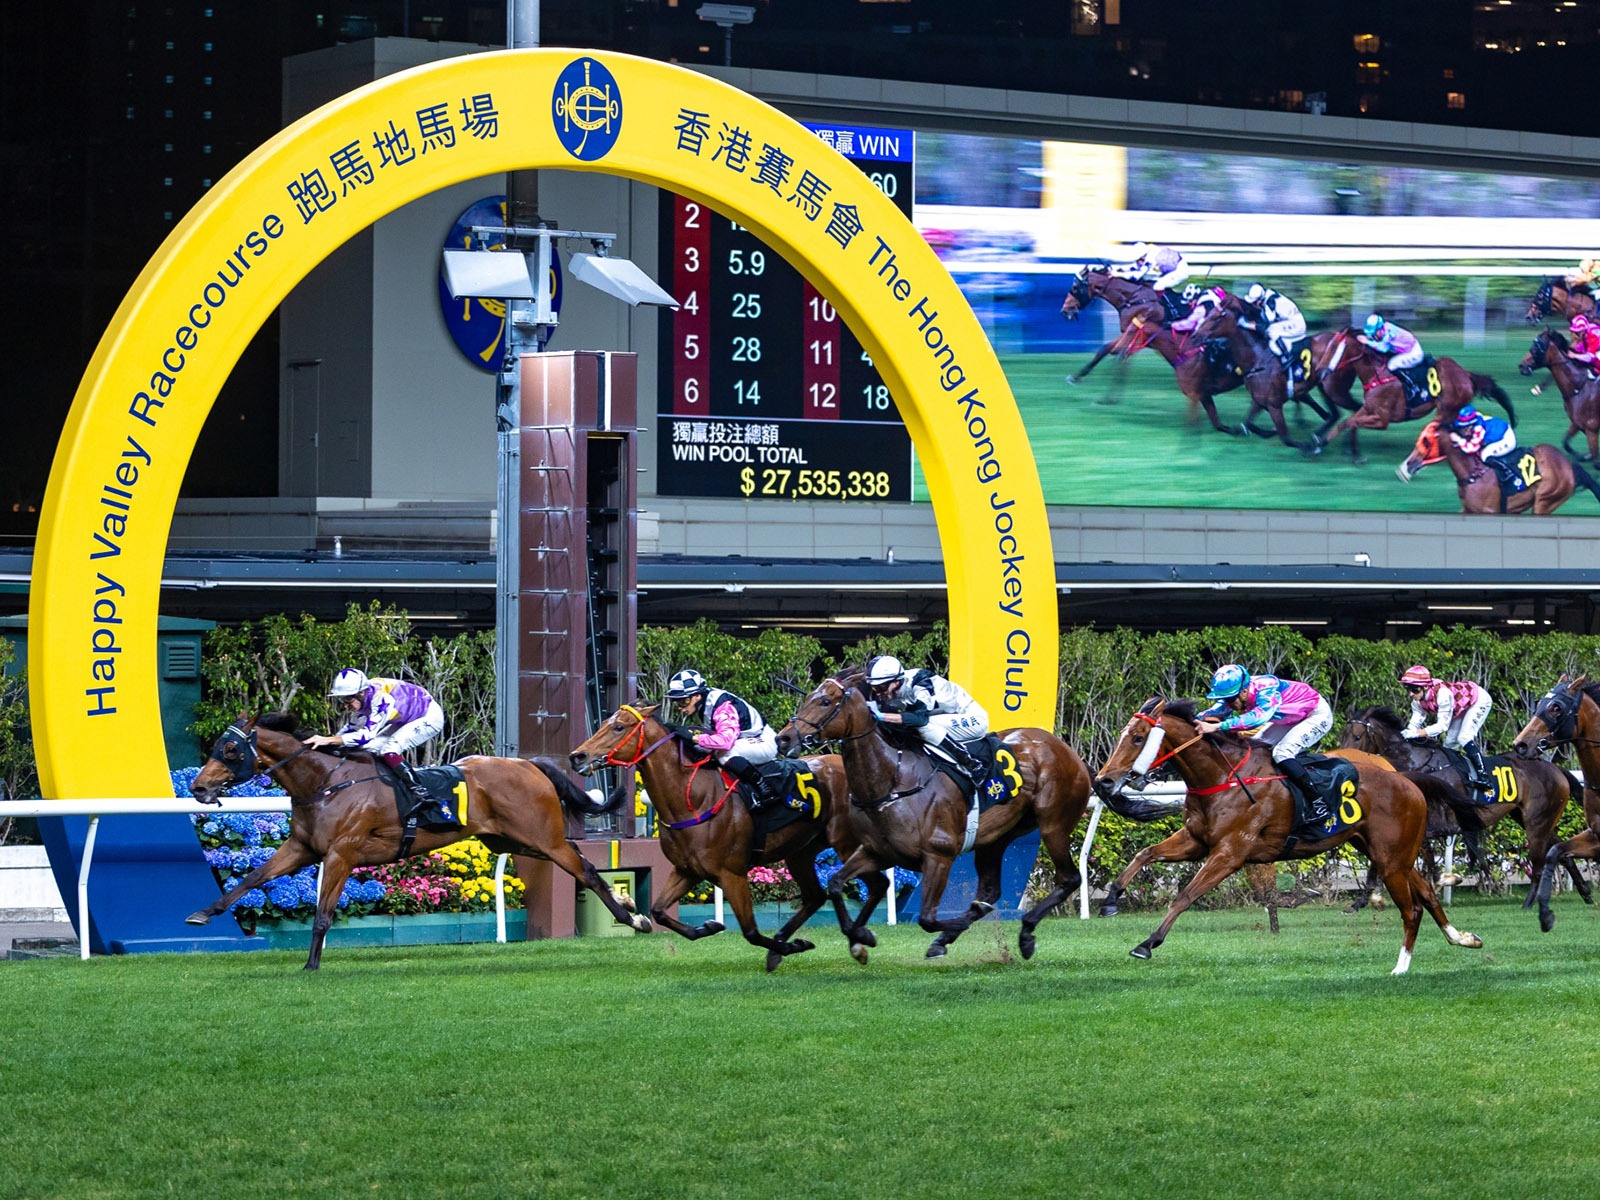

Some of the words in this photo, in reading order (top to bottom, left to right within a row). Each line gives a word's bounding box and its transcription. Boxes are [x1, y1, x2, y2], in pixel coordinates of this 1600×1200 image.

[286, 93, 499, 225] 跑馬地馬場
[858, 134, 900, 157] WIN
[673, 108, 865, 250] 香港賽馬會
[863, 172, 898, 198] 60
[684, 203, 700, 229] 2
[684, 246, 700, 273] 3
[728, 249, 765, 276] 5.9
[868, 235, 911, 302] The
[128, 214, 284, 427] Racecourse
[683, 290, 699, 316] 4
[731, 293, 761, 319] 25
[809, 297, 836, 323] 10
[684, 334, 700, 360] 5
[731, 336, 761, 362] 28
[810, 340, 832, 365] 11
[908, 296, 966, 392] Hong
[1300, 348, 1313, 381] 3
[1426, 366, 1442, 397] 8
[684, 377, 700, 403] 6
[733, 379, 761, 405] 14
[809, 382, 836, 408] 12
[863, 384, 890, 410] 18
[672, 421, 780, 445] 獨贏投注總額
[957, 388, 1002, 484] Kong
[672, 444, 705, 462] WIN
[708, 446, 755, 463] POOL
[759, 447, 808, 464] TOTAL
[1517, 453, 1543, 487] 12
[89, 435, 152, 560] Valley
[740, 466, 756, 497] $
[762, 469, 890, 499] 27,535,338
[990, 492, 1025, 618] Jockey
[85, 572, 126, 717] Happy
[1003, 629, 1031, 712] Club
[996, 749, 1024, 798] 3
[1491, 766, 1518, 803] 10
[452, 781, 469, 827] 1
[796, 772, 822, 819] 5
